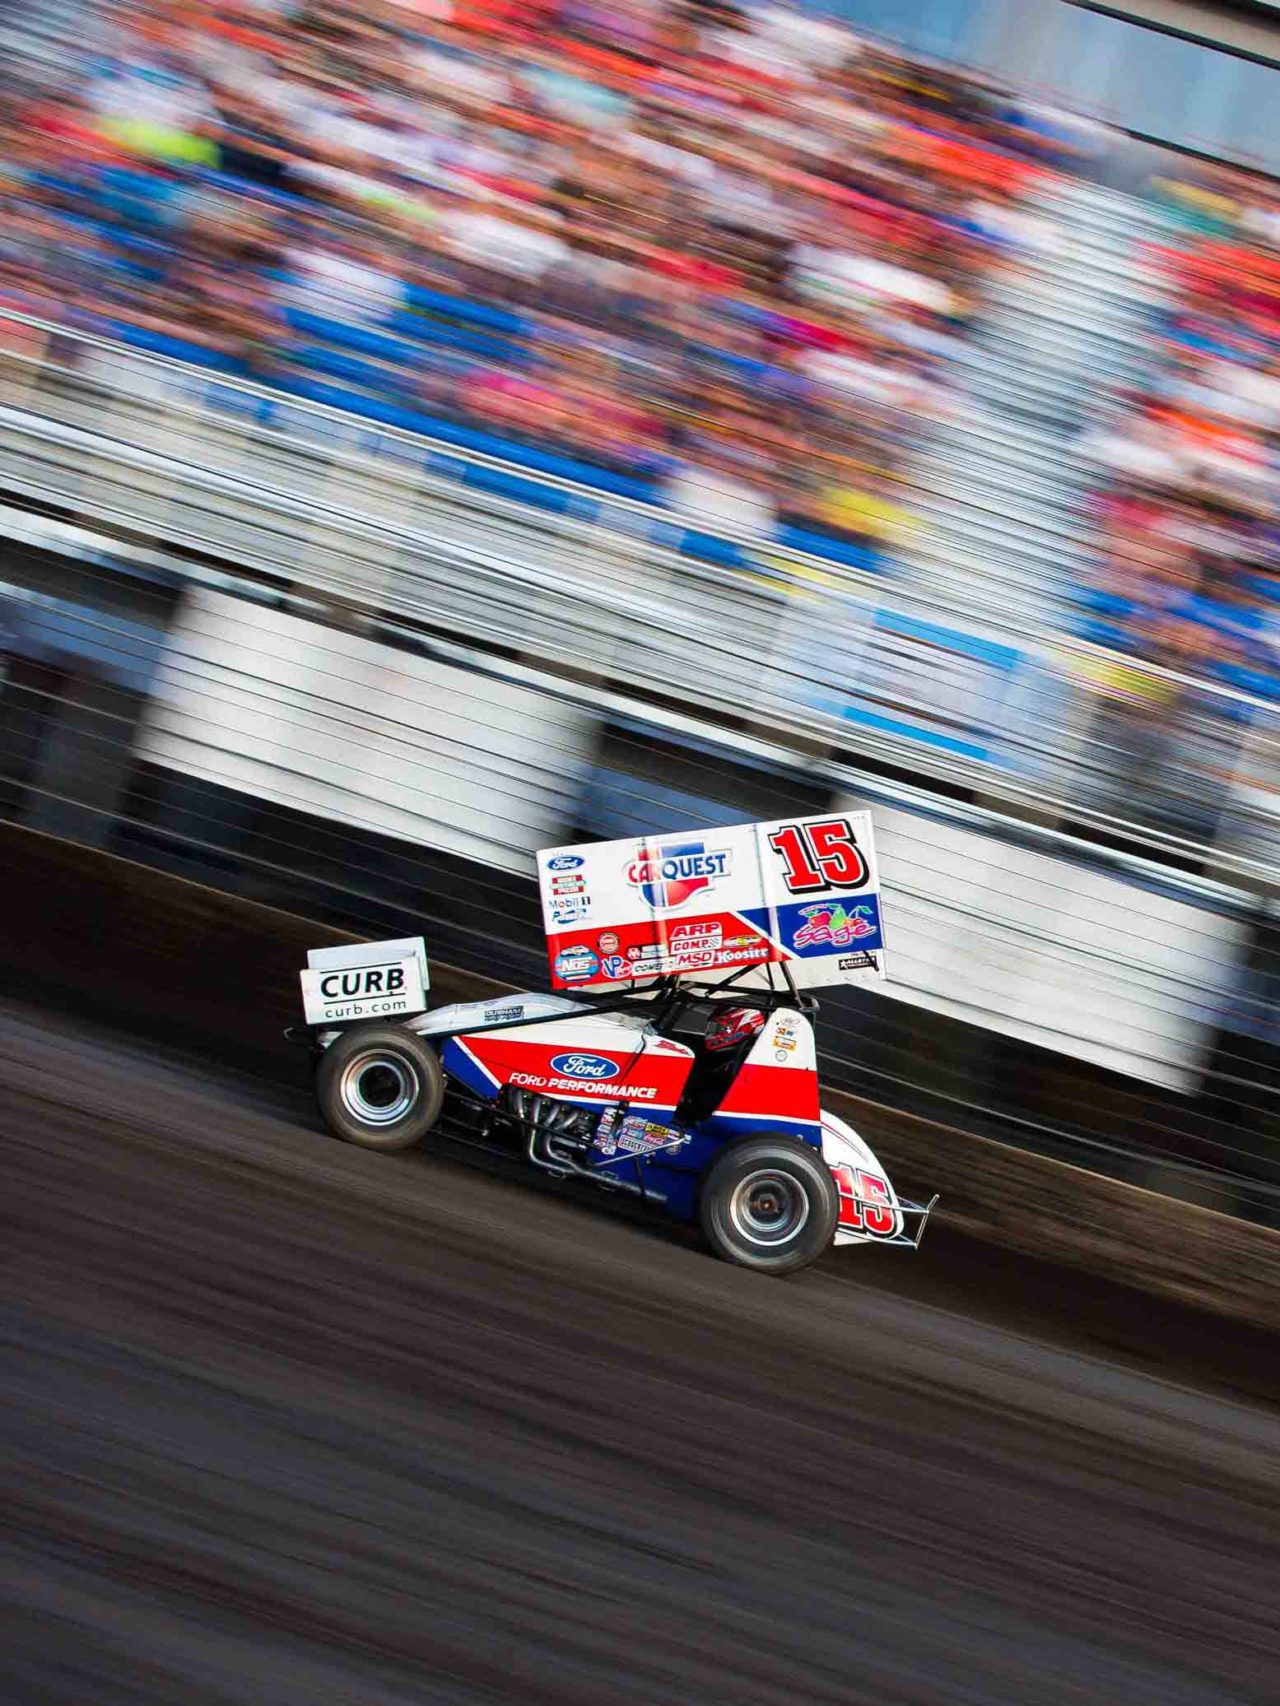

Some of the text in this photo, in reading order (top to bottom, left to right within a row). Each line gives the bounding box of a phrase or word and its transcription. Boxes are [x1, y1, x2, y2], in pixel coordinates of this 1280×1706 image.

[552, 857, 579, 869] Ford
[769, 818, 869, 894] 15
[673, 923, 719, 937] ARP
[674, 939, 709, 951] COMP
[562, 956, 592, 972] NOS
[602, 956, 623, 978] VP
[678, 952, 712, 965] MSD
[320, 968, 404, 998] CURB
[325, 1001, 407, 1018] curb.com
[563, 1055, 606, 1077] Ford
[508, 1073, 658, 1099] FORD PERFORMANCE
[830, 1162, 897, 1238] 15
